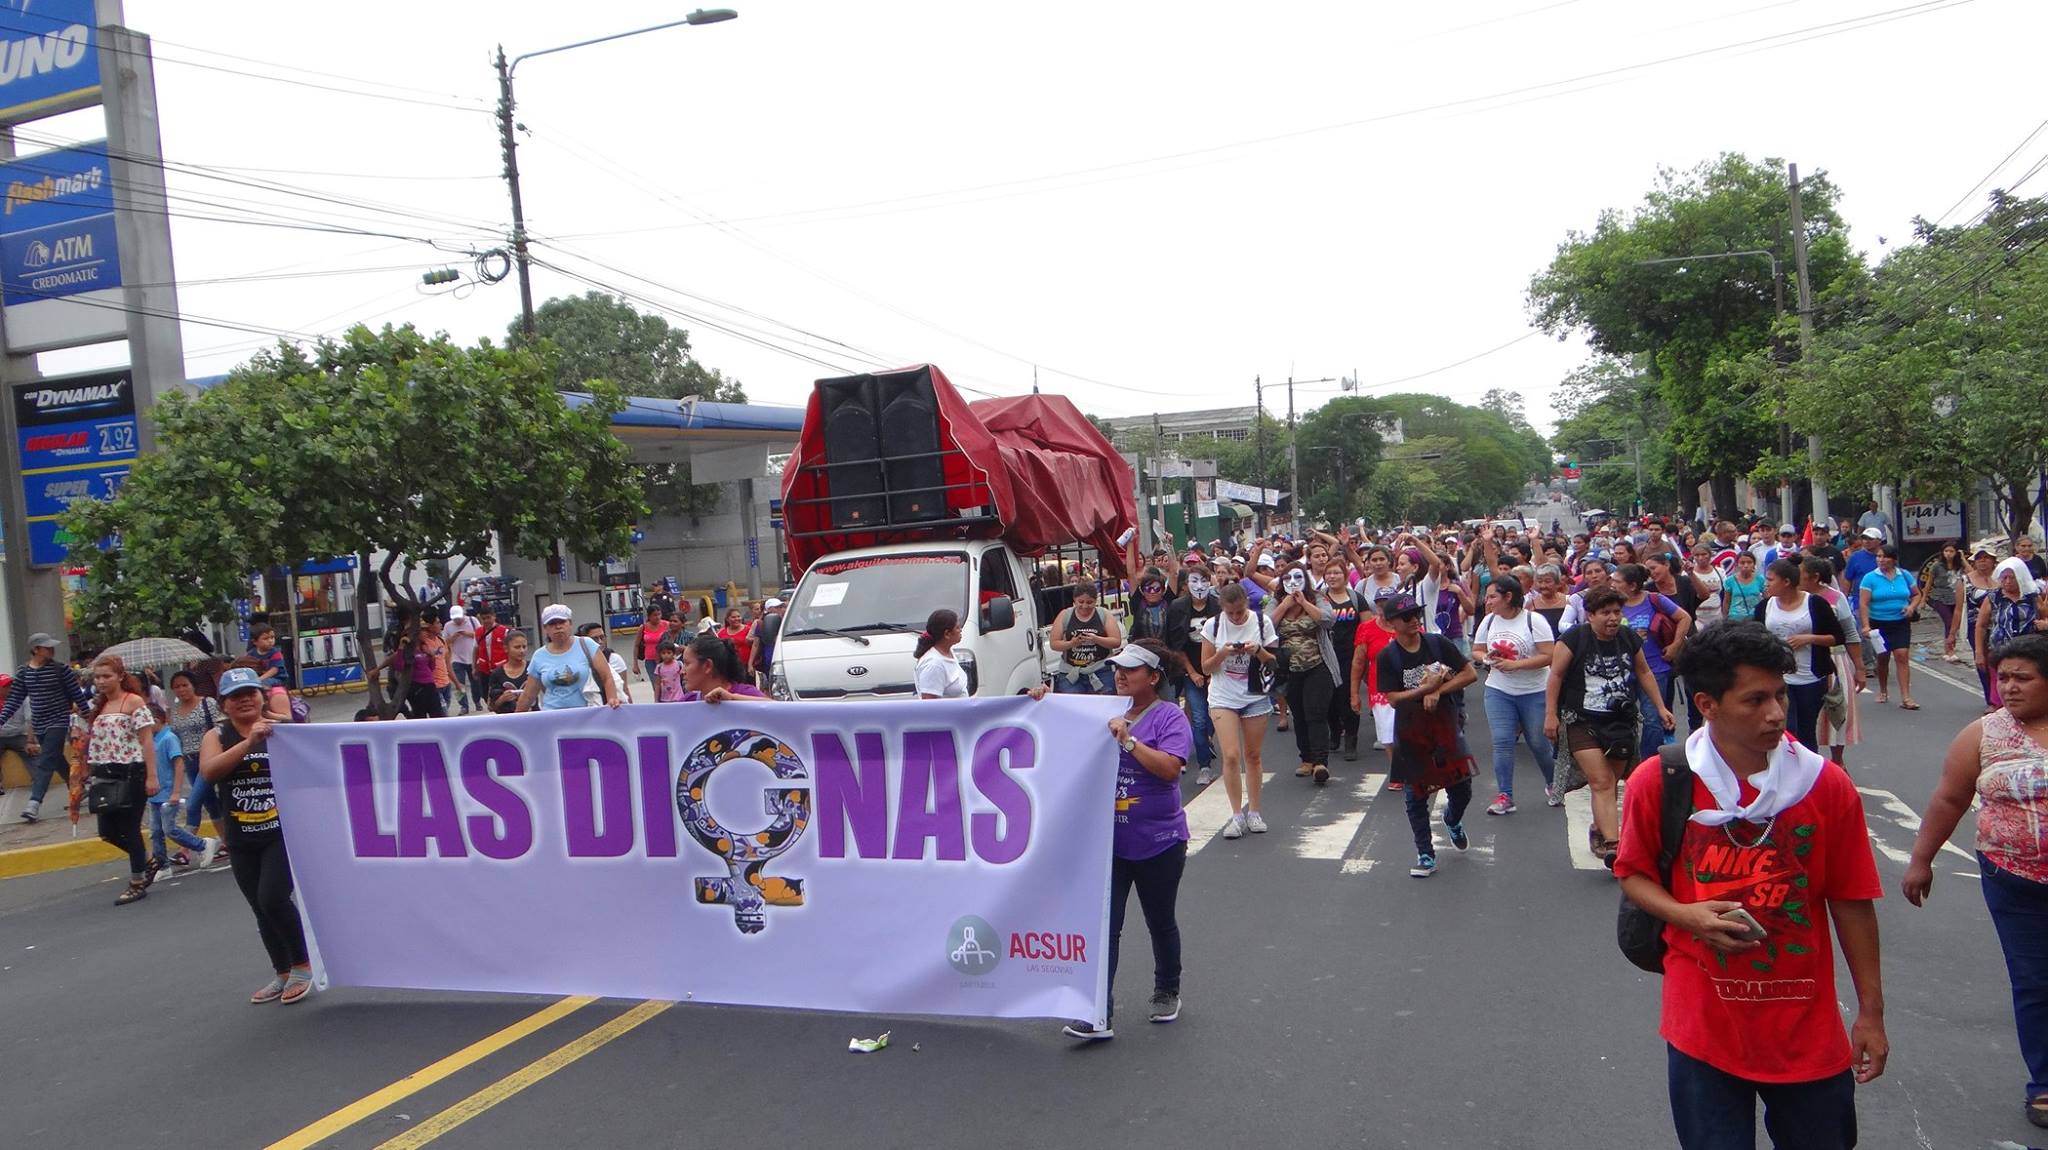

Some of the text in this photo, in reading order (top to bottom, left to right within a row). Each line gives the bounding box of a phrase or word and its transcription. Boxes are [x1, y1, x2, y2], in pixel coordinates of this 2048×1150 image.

[0, 24, 89, 85] UNO
[52, 235, 93, 263] ATM
[32, 268, 98, 290] CREDOMATIC
[37, 380, 124, 407] DYNAMAX
[99, 426, 135, 452] 2.92
[44, 480, 90, 498] SUPER
[339, 726, 1036, 934] LAS DIGNAS
[1698, 845, 1777, 875] NIKE
[1750, 882, 1789, 908] SB
[1009, 932, 1087, 963] ACSUR
